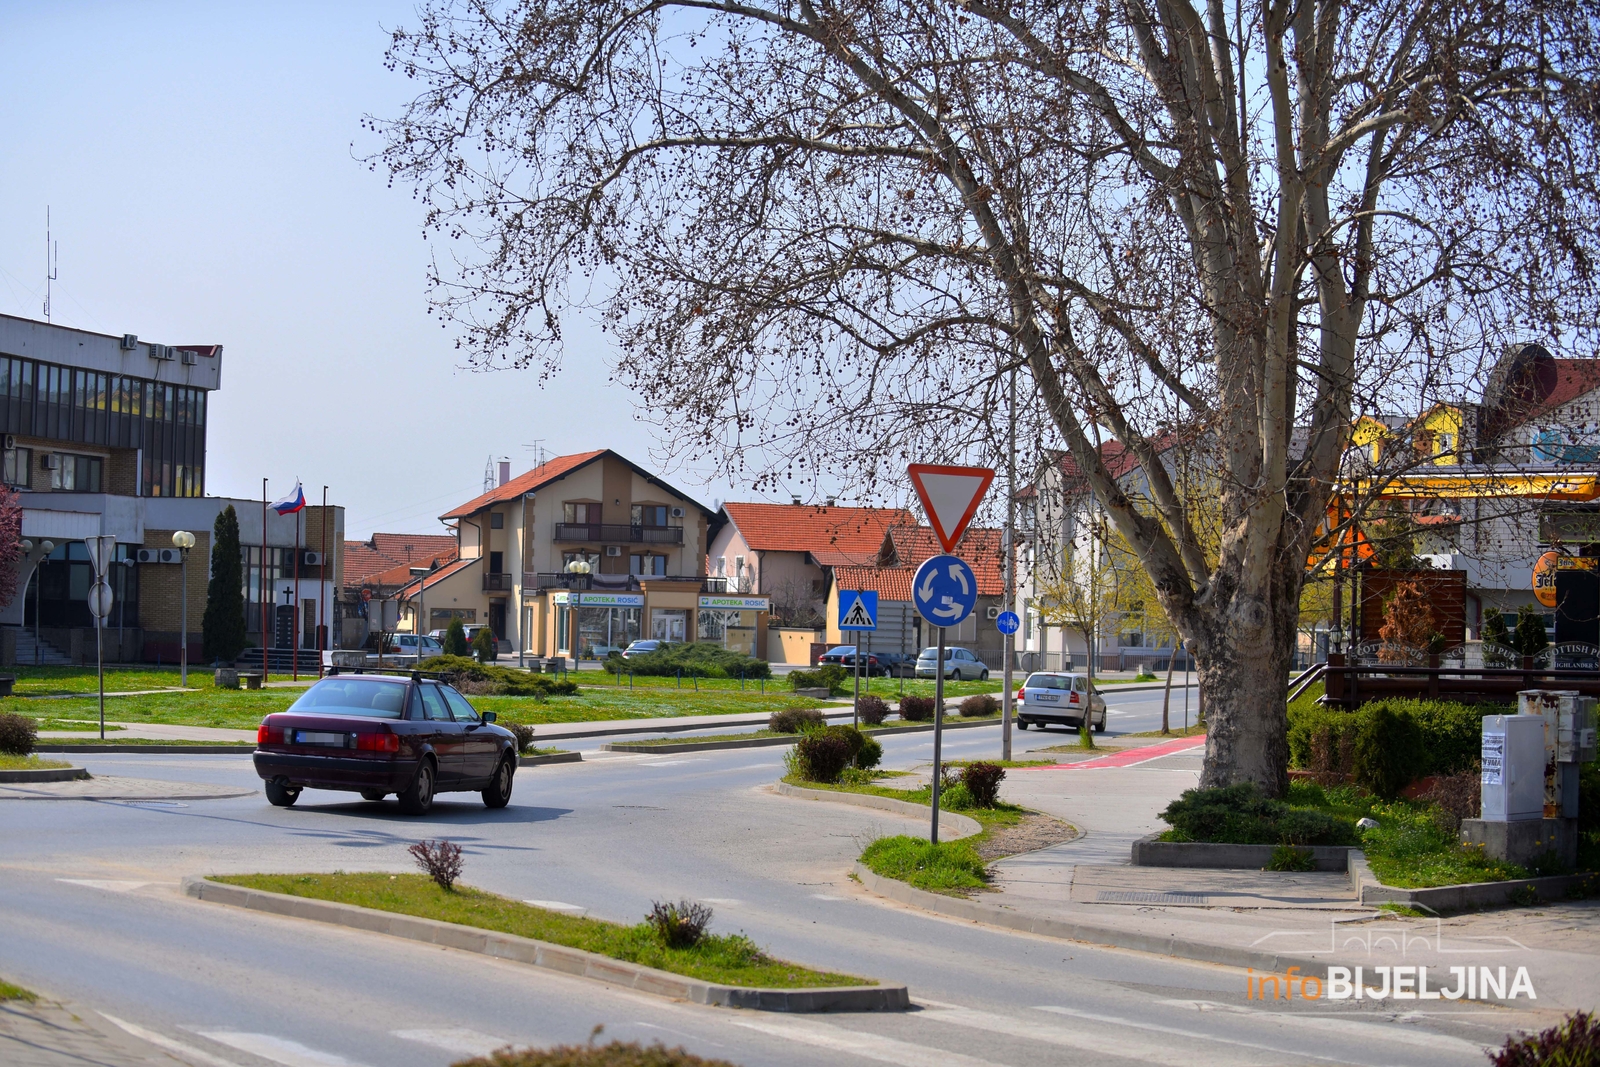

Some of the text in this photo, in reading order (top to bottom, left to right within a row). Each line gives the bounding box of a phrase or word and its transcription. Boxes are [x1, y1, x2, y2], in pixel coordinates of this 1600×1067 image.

[617, 596, 639, 604] ROSIĆ
[744, 599, 766, 607] ROSIĆ
[1404, 646, 1424, 660] PUB
[1446, 644, 1517, 661] SCOSH PUB
[1539, 644, 1589, 662] SCOTTISH
